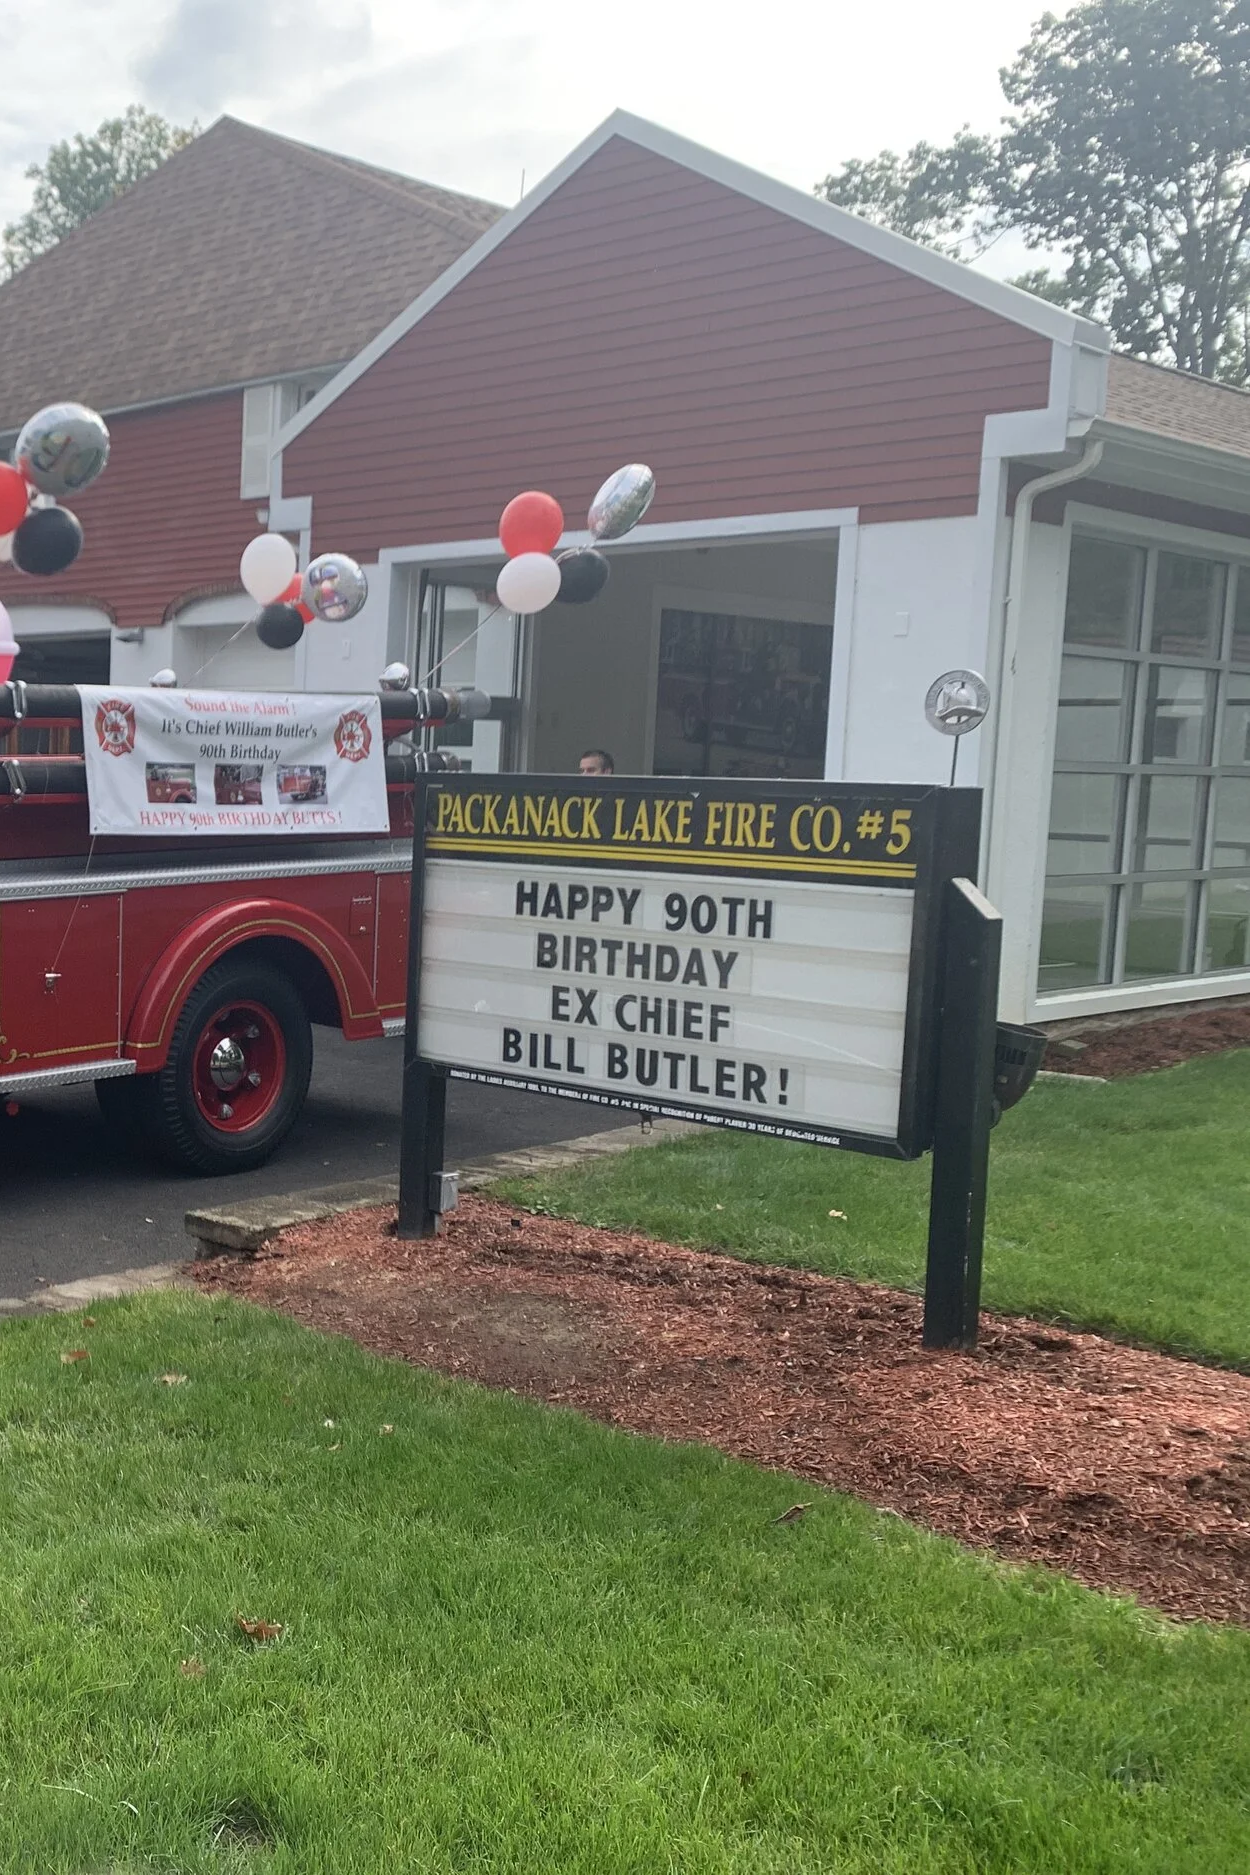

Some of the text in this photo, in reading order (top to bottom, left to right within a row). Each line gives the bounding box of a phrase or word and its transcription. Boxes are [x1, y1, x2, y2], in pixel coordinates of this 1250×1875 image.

[162, 719, 318, 738] It's Chief William Butler's
[184, 692, 226, 714] Sound
[230, 699, 250, 714] the
[199, 744, 282, 762] 90th Birthday
[140, 810, 186, 826] HAPPY
[189, 813, 214, 827] 90th
[218, 811, 291, 826] BIRTHDAY
[436, 792, 912, 857] PACKANACK LAKE FIRE CO. #5
[515, 880, 774, 940] HAPPY 90TH
[536, 932, 740, 990] BIRTHDAY
[550, 985, 733, 1043] EX CHIEF
[502, 1027, 791, 1106] BILL BUTLER!
